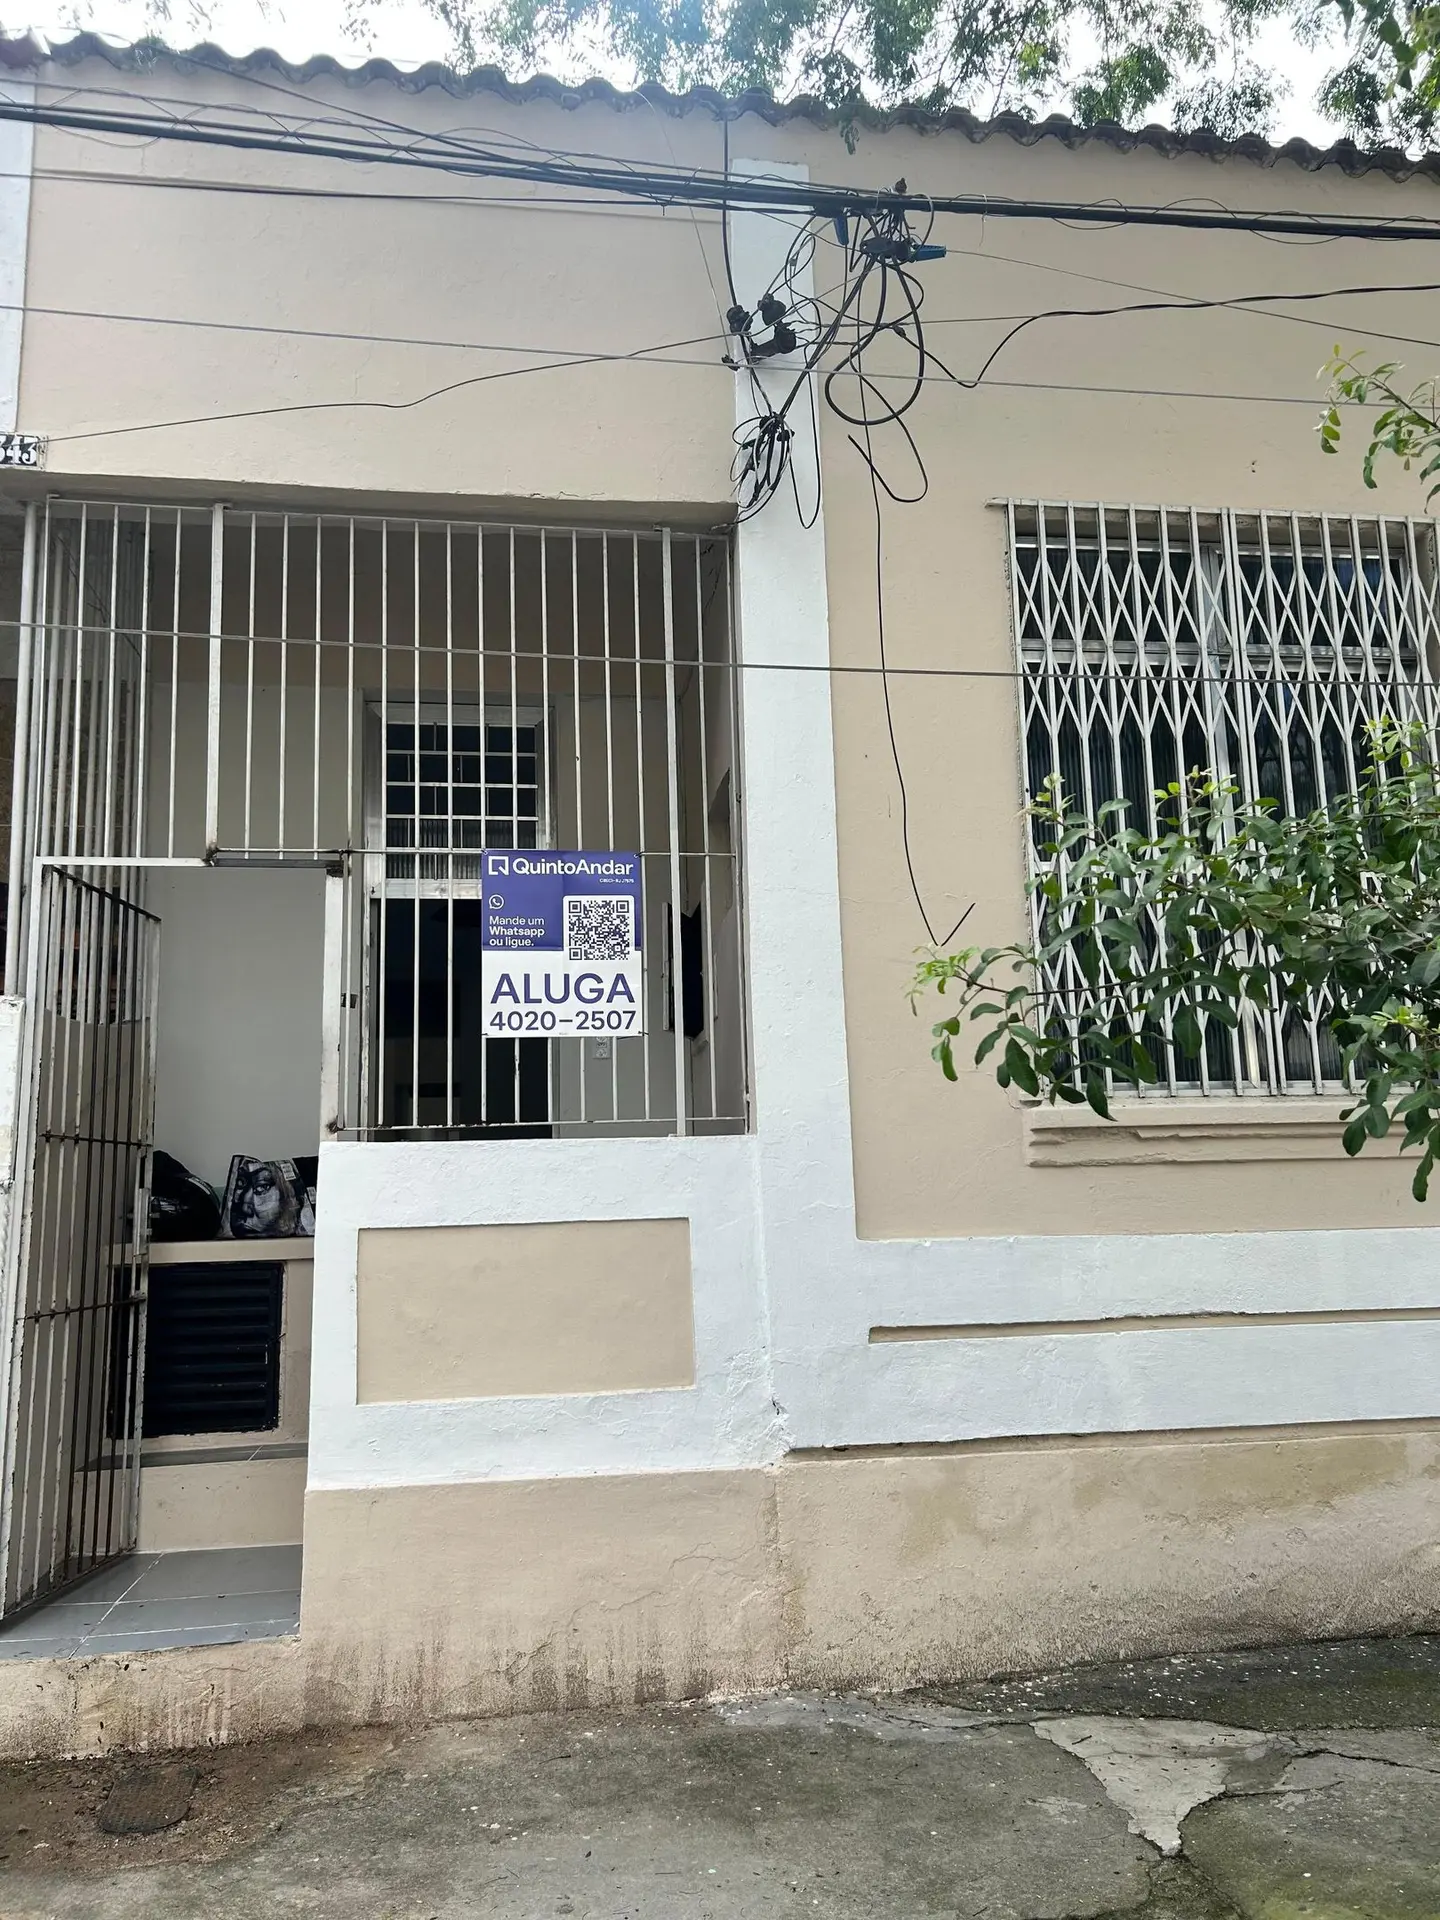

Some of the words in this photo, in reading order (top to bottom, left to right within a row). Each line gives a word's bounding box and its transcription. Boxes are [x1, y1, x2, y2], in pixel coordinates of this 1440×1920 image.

[512, 858, 634, 875] QuintoAndar
[489, 916, 526, 926] Mande
[528, 918, 544, 926] um
[489, 927, 545, 938] Whatsapp
[489, 939, 503, 947] ou
[505, 937, 534, 948] ligue.
[490, 973, 635, 1004] ALUGA
[489, 1011, 636, 1031] 4020-2507
